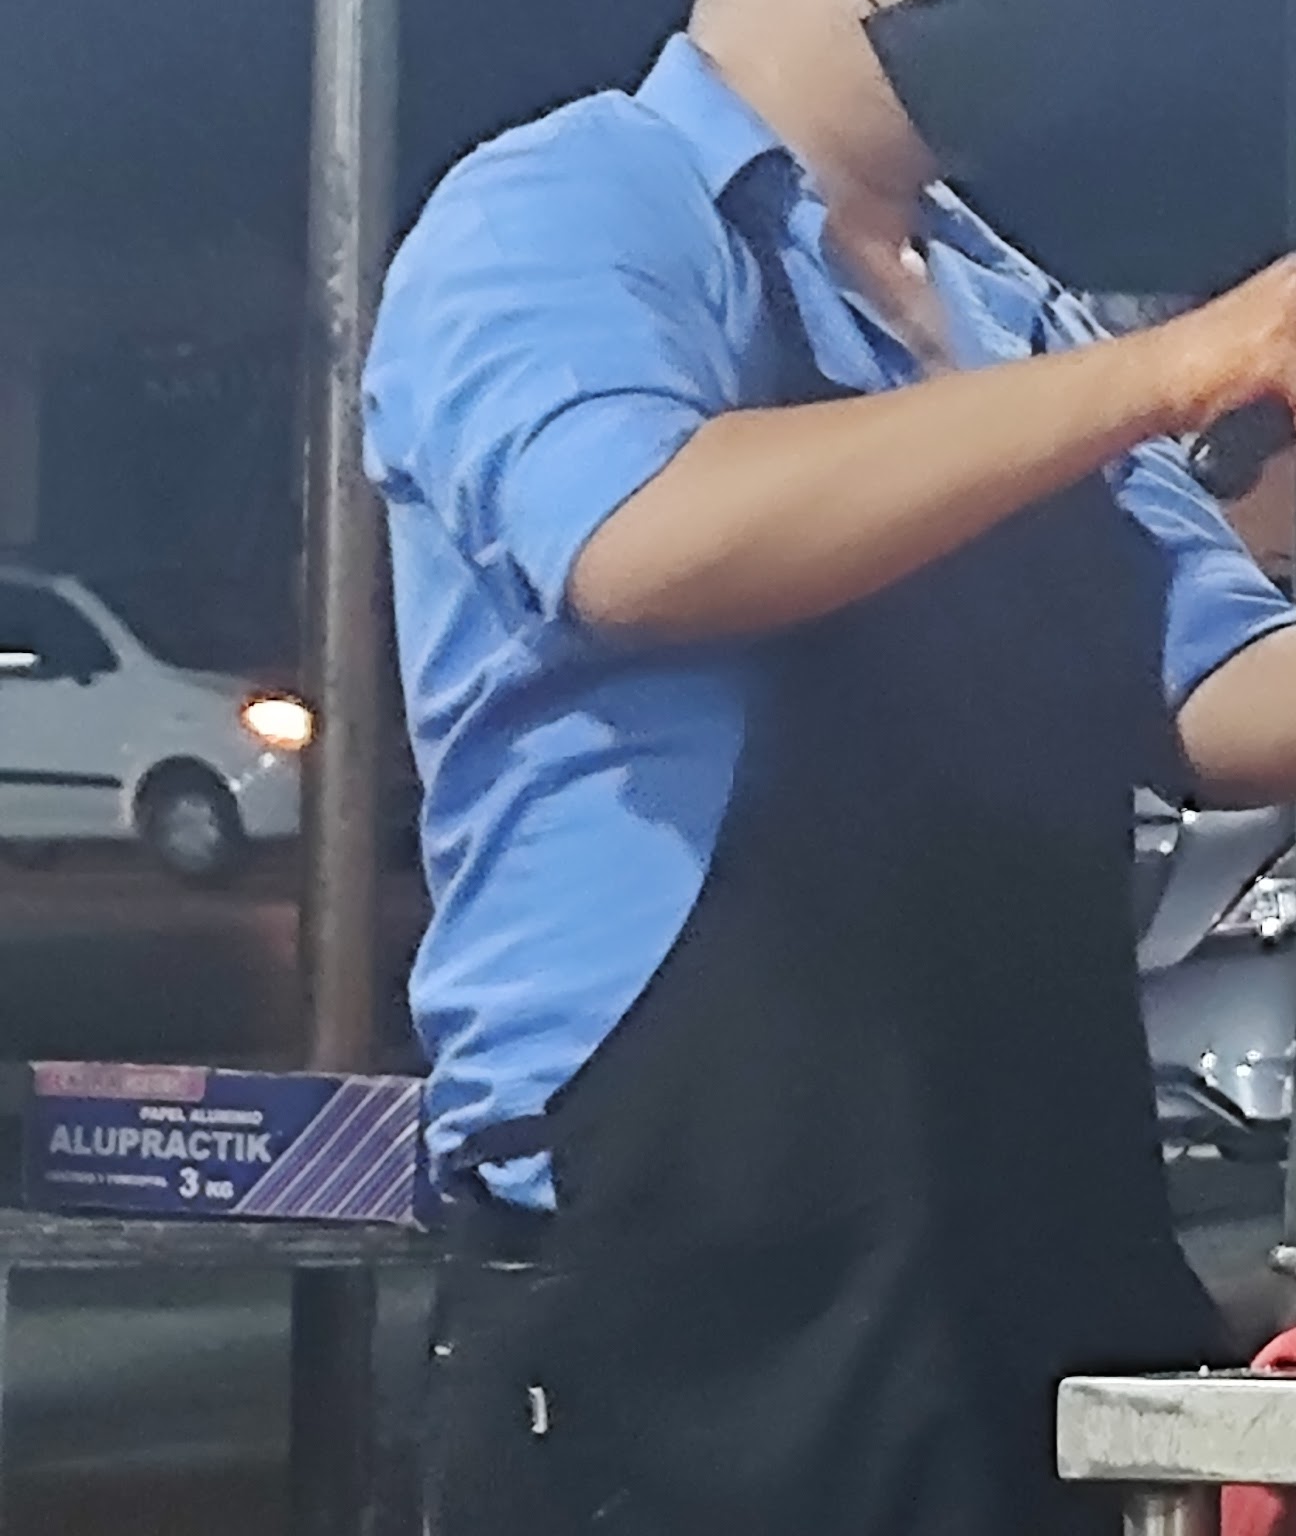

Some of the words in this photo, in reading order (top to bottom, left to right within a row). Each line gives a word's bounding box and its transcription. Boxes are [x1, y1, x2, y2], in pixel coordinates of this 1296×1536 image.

[49, 1124, 273, 1163] ALUPRACTIK
[178, 1166, 200, 1199] 3
[205, 1180, 235, 1200] KG
